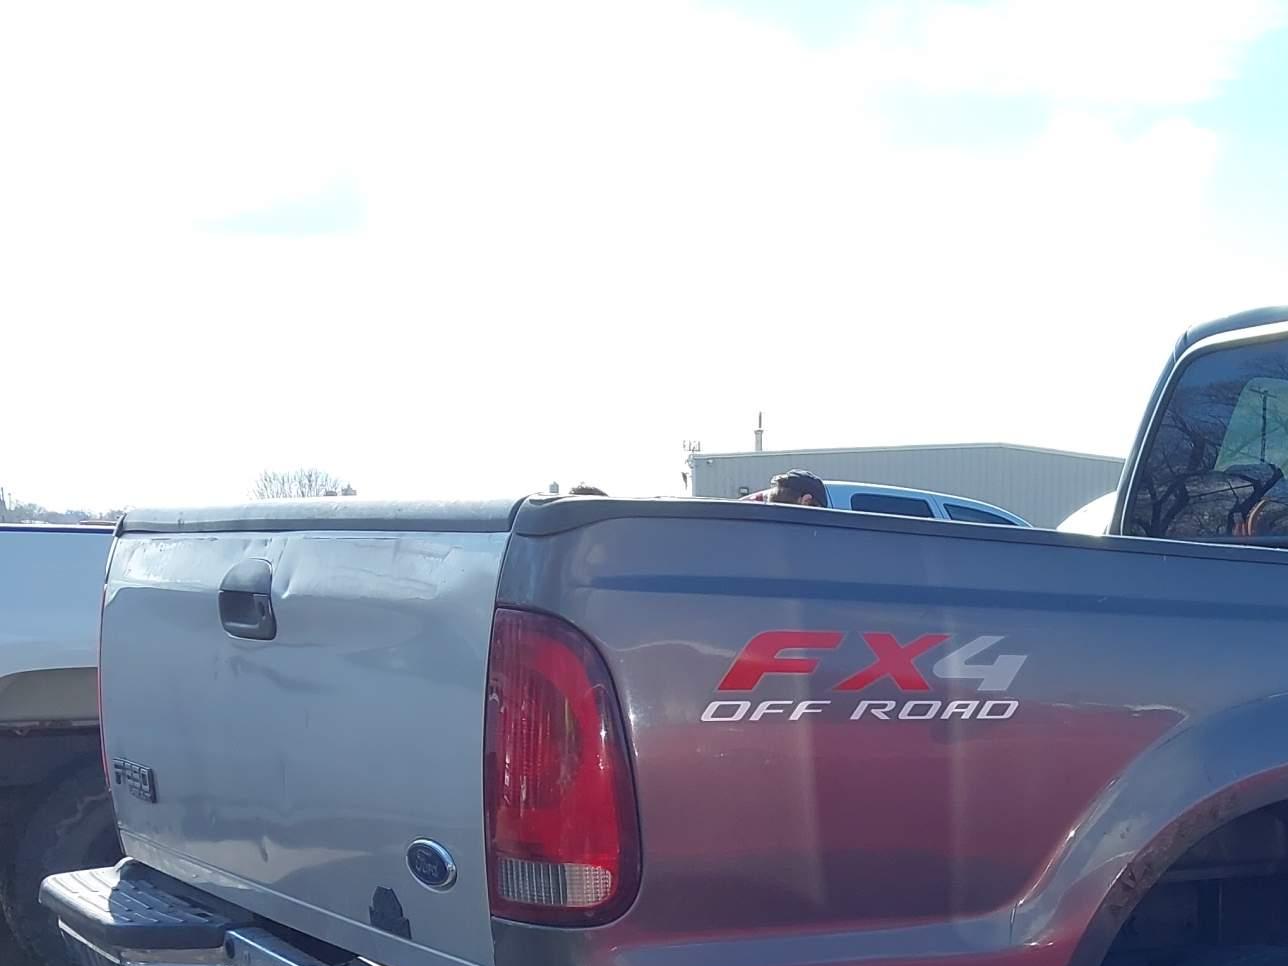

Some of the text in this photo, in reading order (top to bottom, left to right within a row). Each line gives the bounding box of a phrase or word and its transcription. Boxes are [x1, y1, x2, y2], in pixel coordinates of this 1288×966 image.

[714, 629, 1028, 692] FX4
[700, 700, 1020, 722] OFF ROAD
